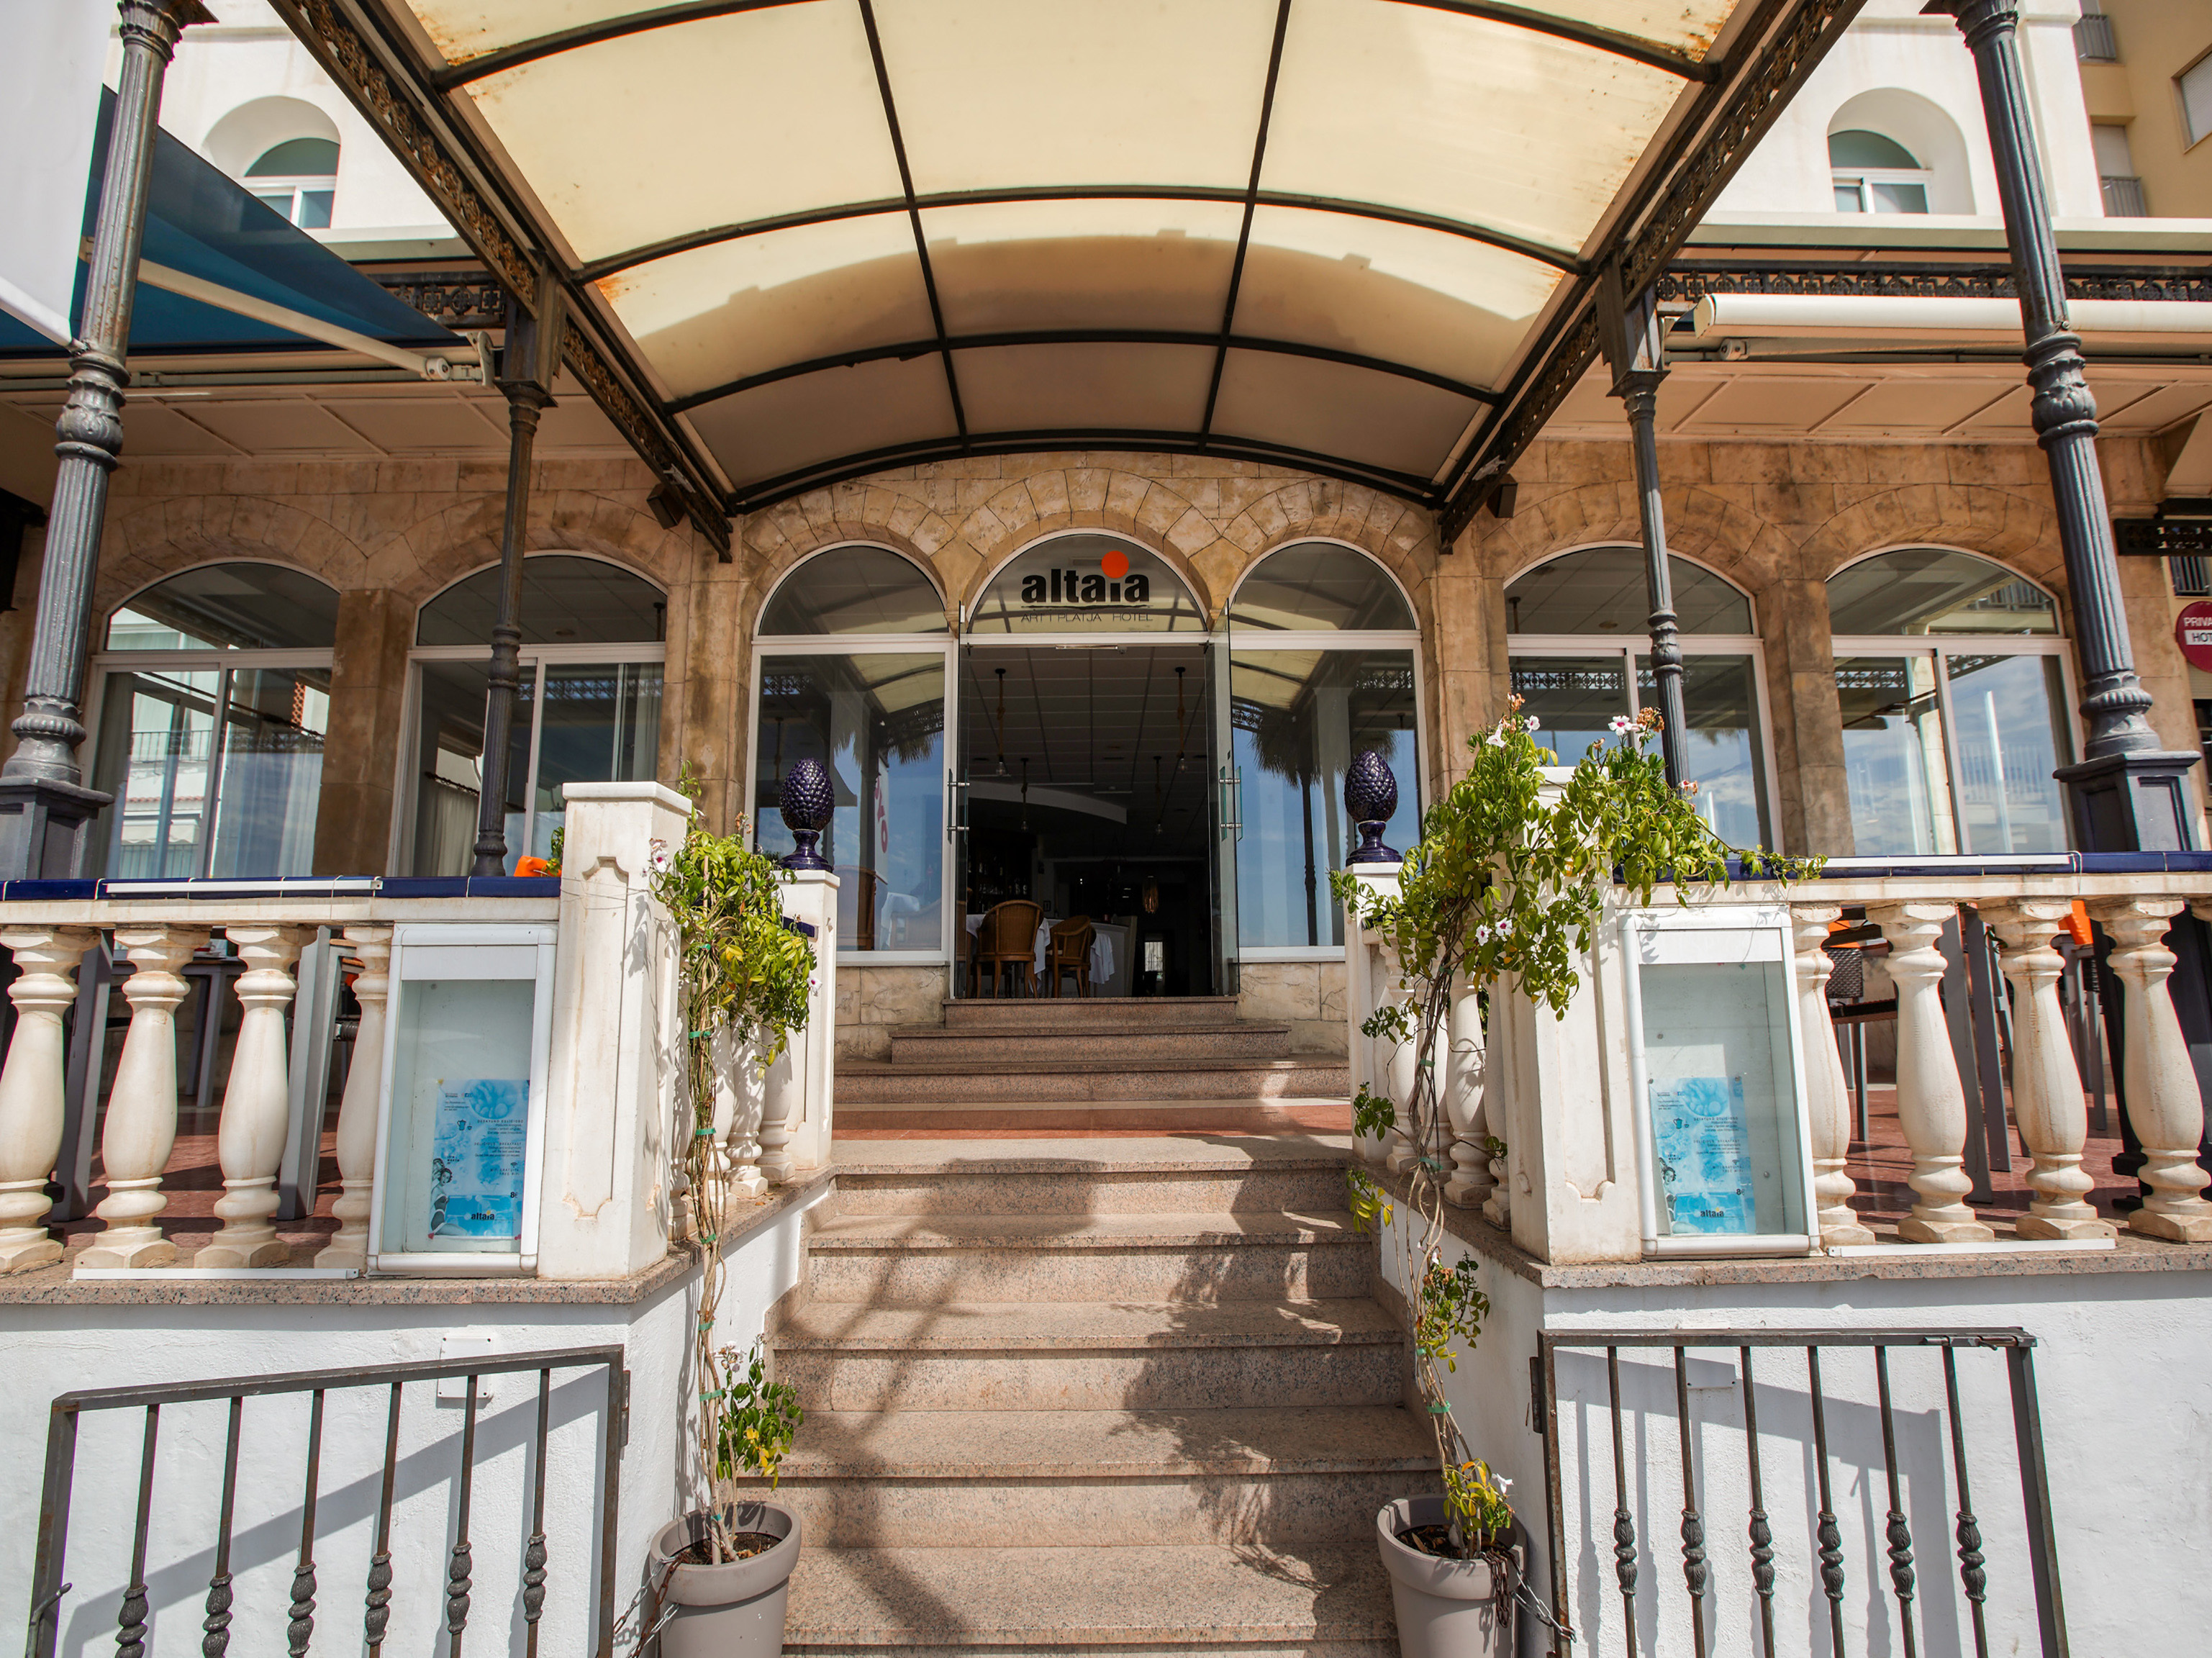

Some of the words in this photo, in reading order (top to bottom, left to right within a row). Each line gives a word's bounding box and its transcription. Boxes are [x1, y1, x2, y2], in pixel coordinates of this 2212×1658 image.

[1021, 551, 1150, 604] altaia
[1020, 612, 1043, 622] ART
[1058, 612, 1102, 622] PLATJA
[1112, 612, 1153, 622] HOTEL
[471, 1210, 495, 1220] altaia
[1700, 1208, 1724, 1218] altaia
